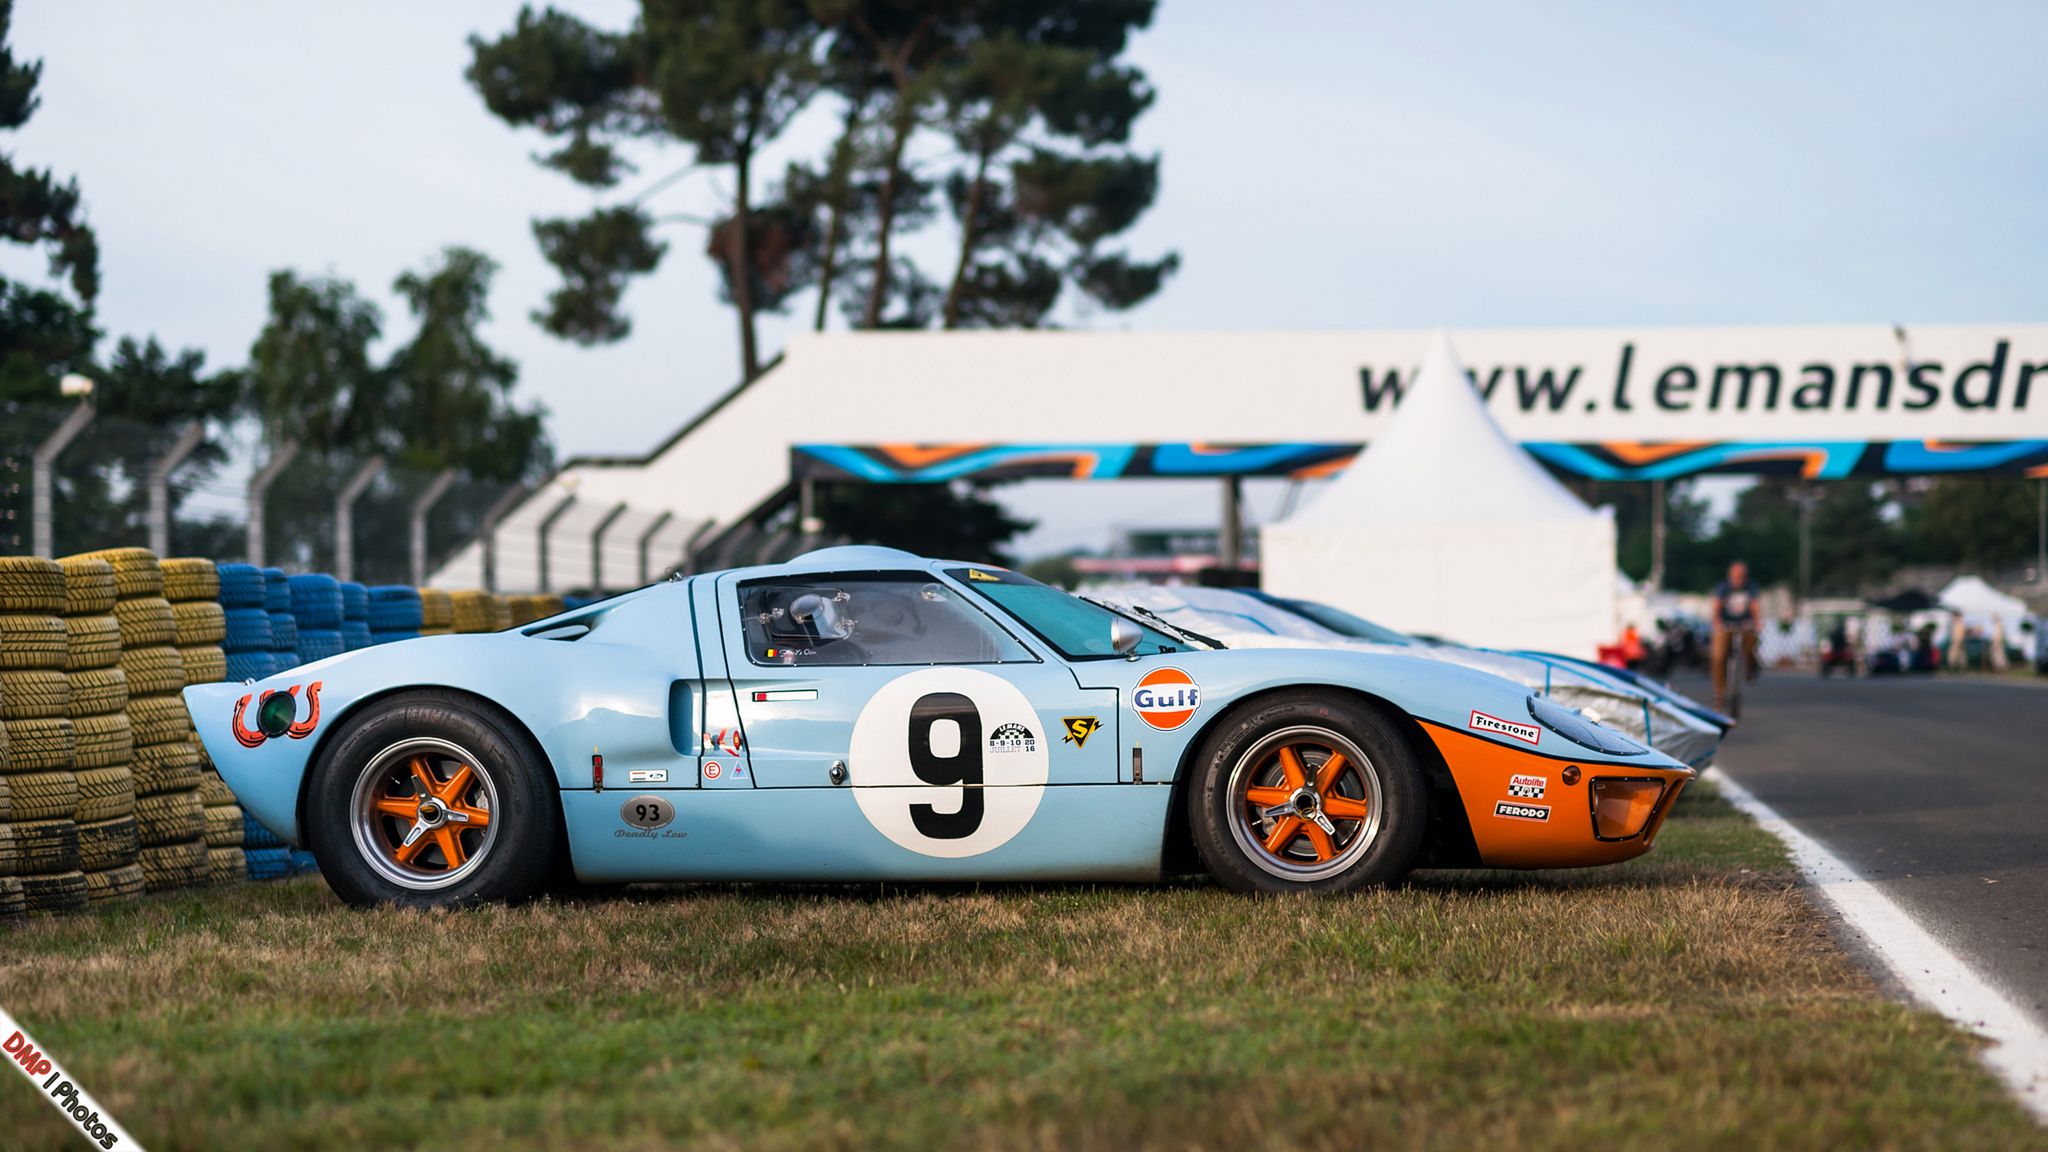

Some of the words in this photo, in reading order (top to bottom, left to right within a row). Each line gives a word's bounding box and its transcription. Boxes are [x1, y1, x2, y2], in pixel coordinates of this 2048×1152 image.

[1134, 689, 1198, 708] Gulf
[1476, 716, 1535, 737] Firestone
[909, 692, 984, 839] 9
[1513, 777, 1544, 787] Autolite
[636, 804, 660, 821] 93
[1499, 805, 1545, 818] FERODO
[614, 829, 658, 840] Deadly
[661, 829, 687, 838] Low
